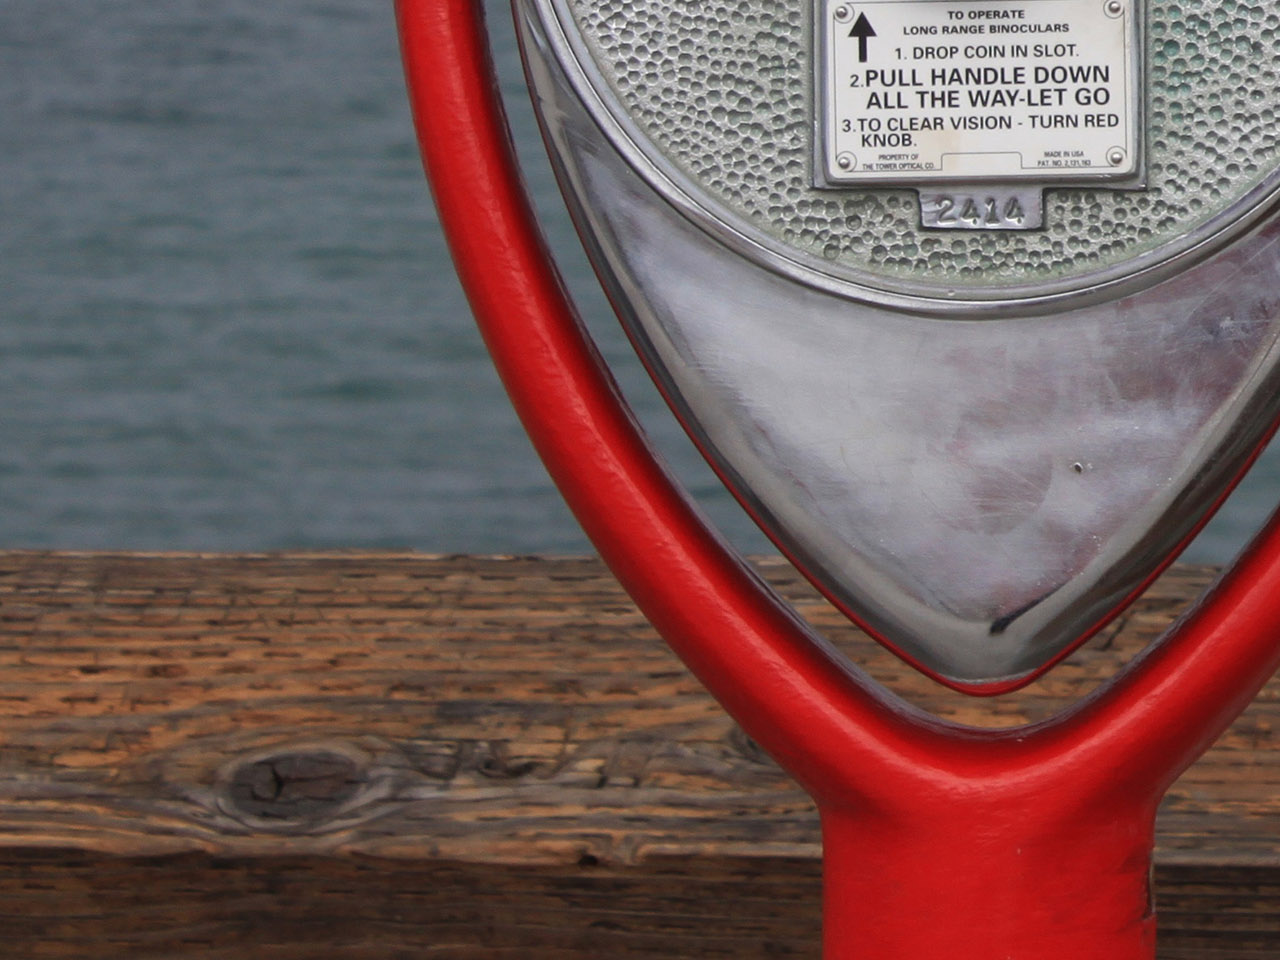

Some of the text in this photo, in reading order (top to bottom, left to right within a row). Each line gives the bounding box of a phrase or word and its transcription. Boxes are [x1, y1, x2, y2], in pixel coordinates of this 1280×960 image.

[948, 10, 1025, 20] TO OPERATE
[903, 24, 1070, 35] LONG RANGE BINOCULARS
[896, 44, 1079, 60] 1. DROP COIN IN SLOT.
[931, 67, 1025, 85] HANDLE
[1034, 65, 1109, 83] DOWN
[866, 91, 908, 109] ALL
[916, 91, 959, 108] THE
[1075, 88, 1110, 105] GO
[888, 117, 944, 131] CLEAR
[950, 116, 1012, 130] VISION
[1028, 115, 1078, 128] TURN
[1085, 114, 1119, 127] RED
[861, 134, 917, 147] KNOB.
[936, 196, 1025, 225] 2414
